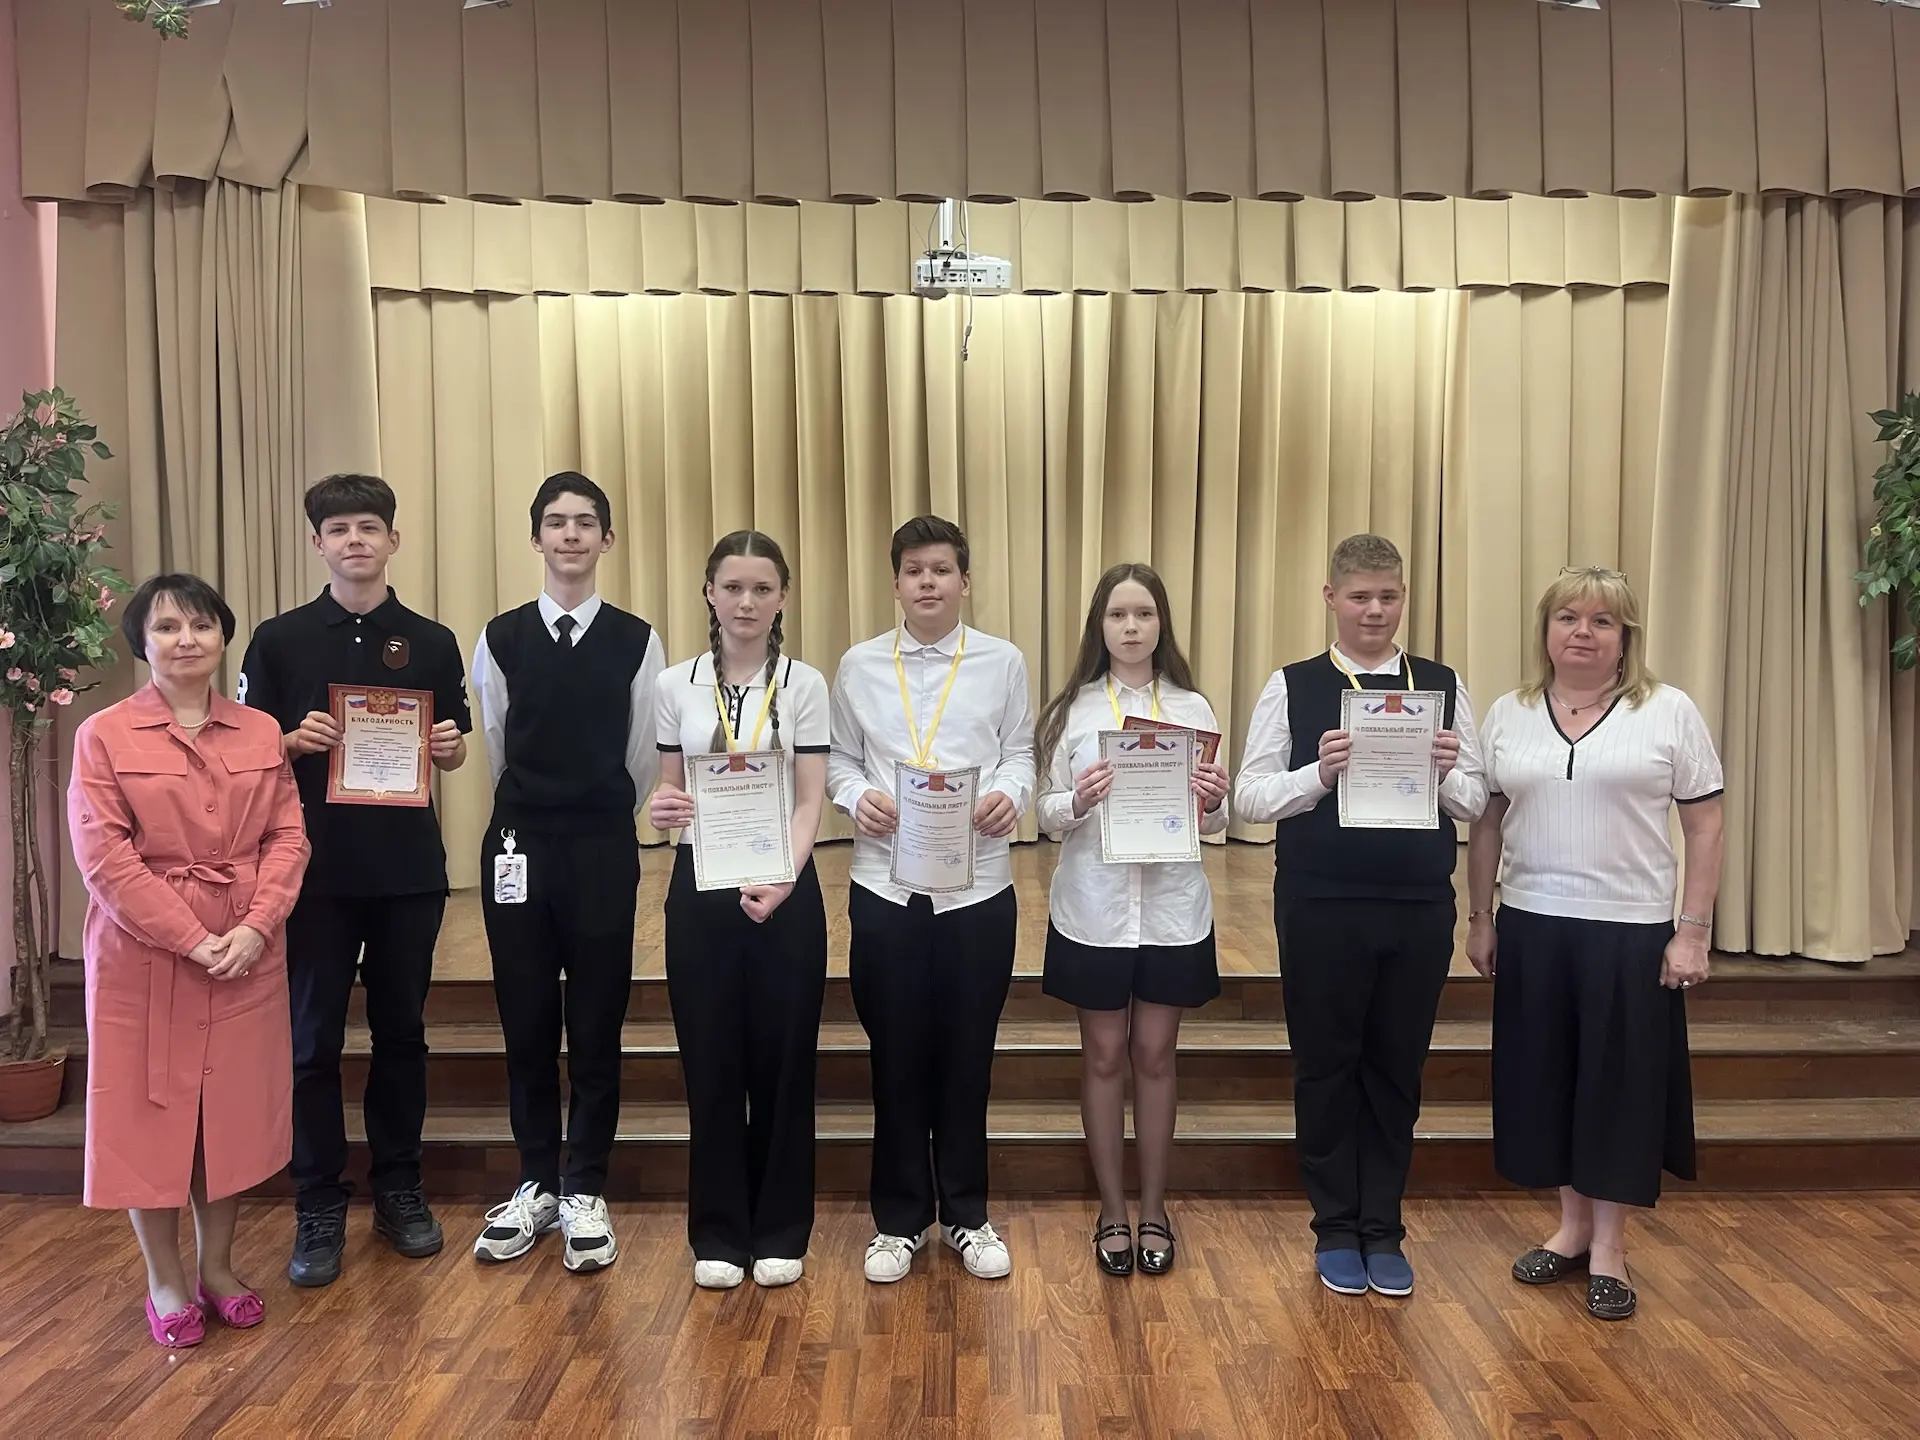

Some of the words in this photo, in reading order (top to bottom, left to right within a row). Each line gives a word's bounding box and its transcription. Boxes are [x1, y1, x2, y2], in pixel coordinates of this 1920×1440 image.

[351, 716, 414, 725] БЛАГОДАРНОСТЬ
[1117, 761, 1159, 769] ПОХВАЛЬНЫЙ
[707, 783, 750, 793] ПОХВАЛЬНЫЙ
[751, 782, 768, 790] ЛИСТ
